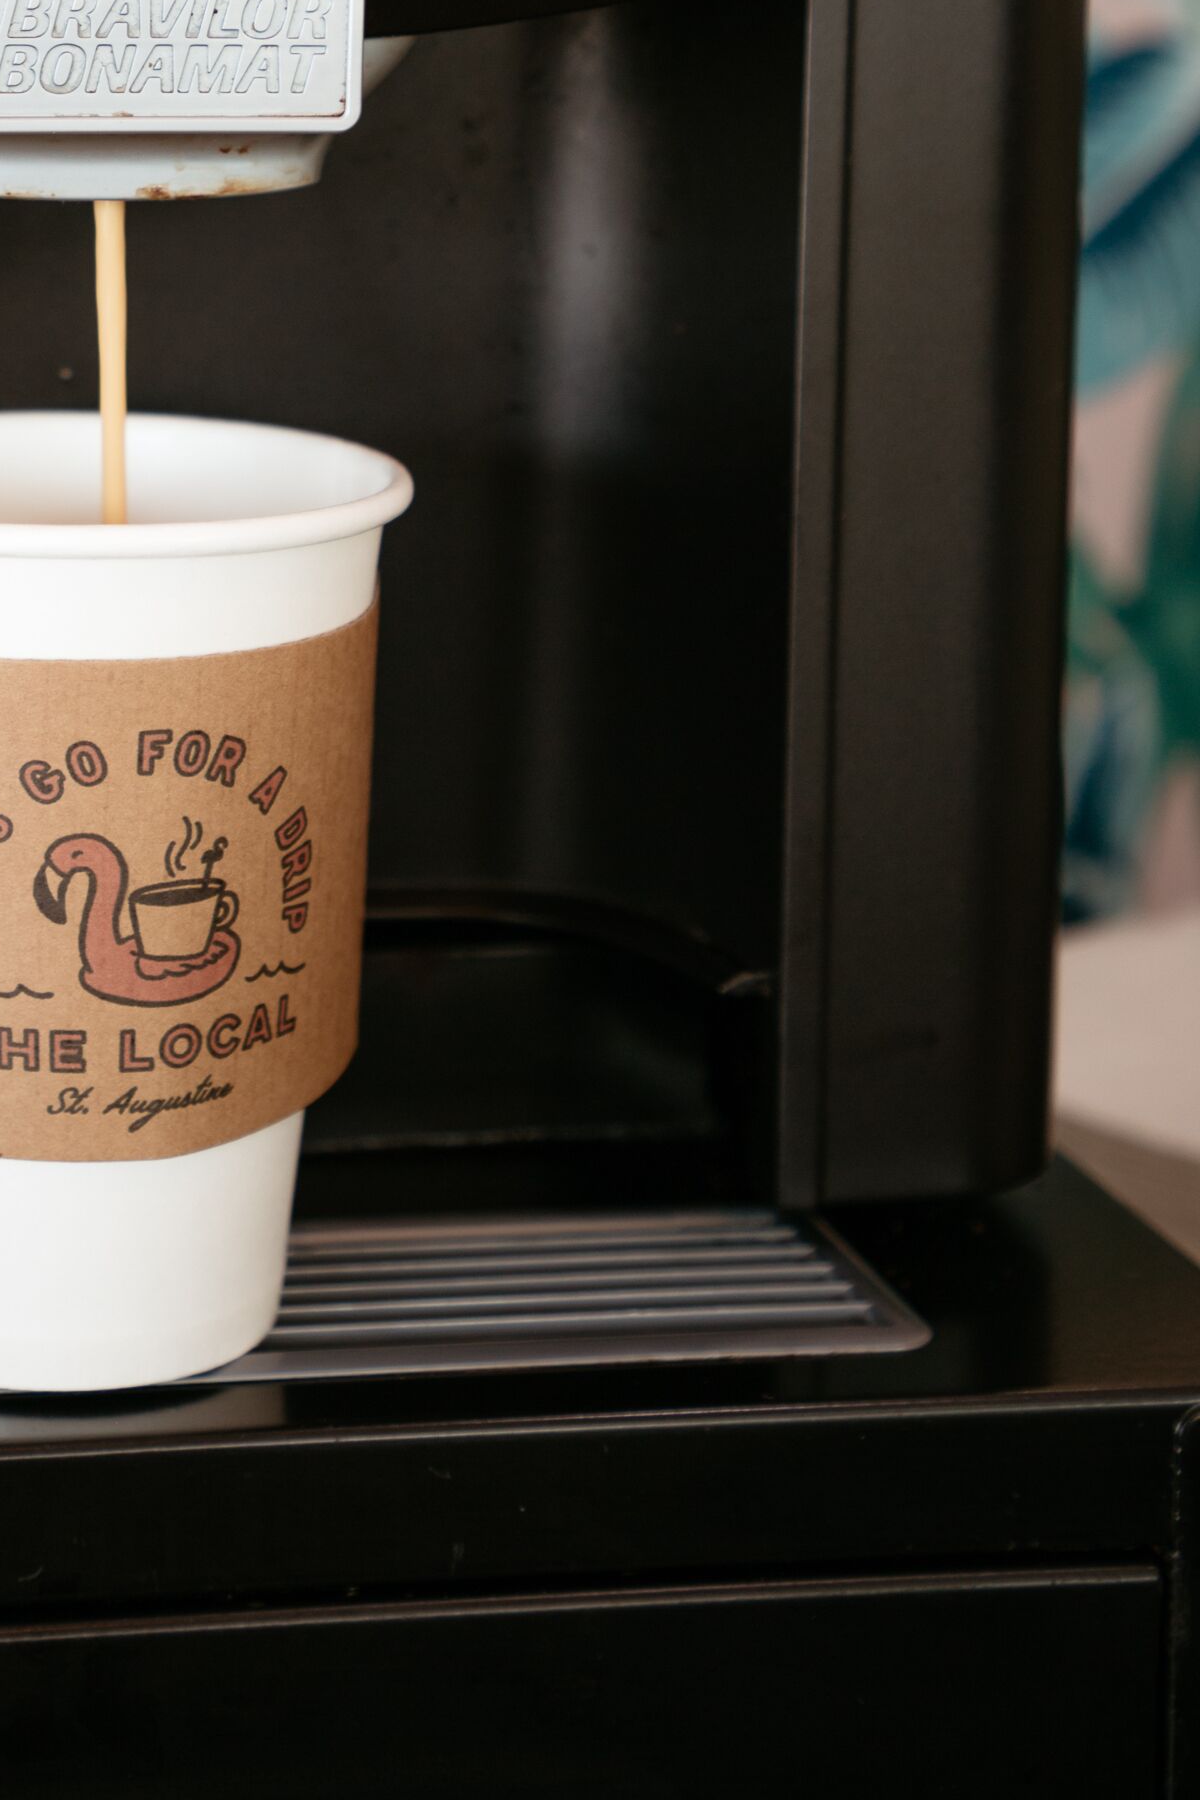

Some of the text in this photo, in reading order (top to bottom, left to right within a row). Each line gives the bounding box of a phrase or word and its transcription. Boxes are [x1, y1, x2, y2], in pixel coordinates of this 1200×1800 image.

[19, 740, 108, 805] GO
[136, 729, 247, 788] FOR
[248, 766, 288, 815] A
[275, 806, 313, 934] DRIP
[118, 994, 297, 1074] LOCAL
[47, 1074, 235, 1134] St. Augustine
